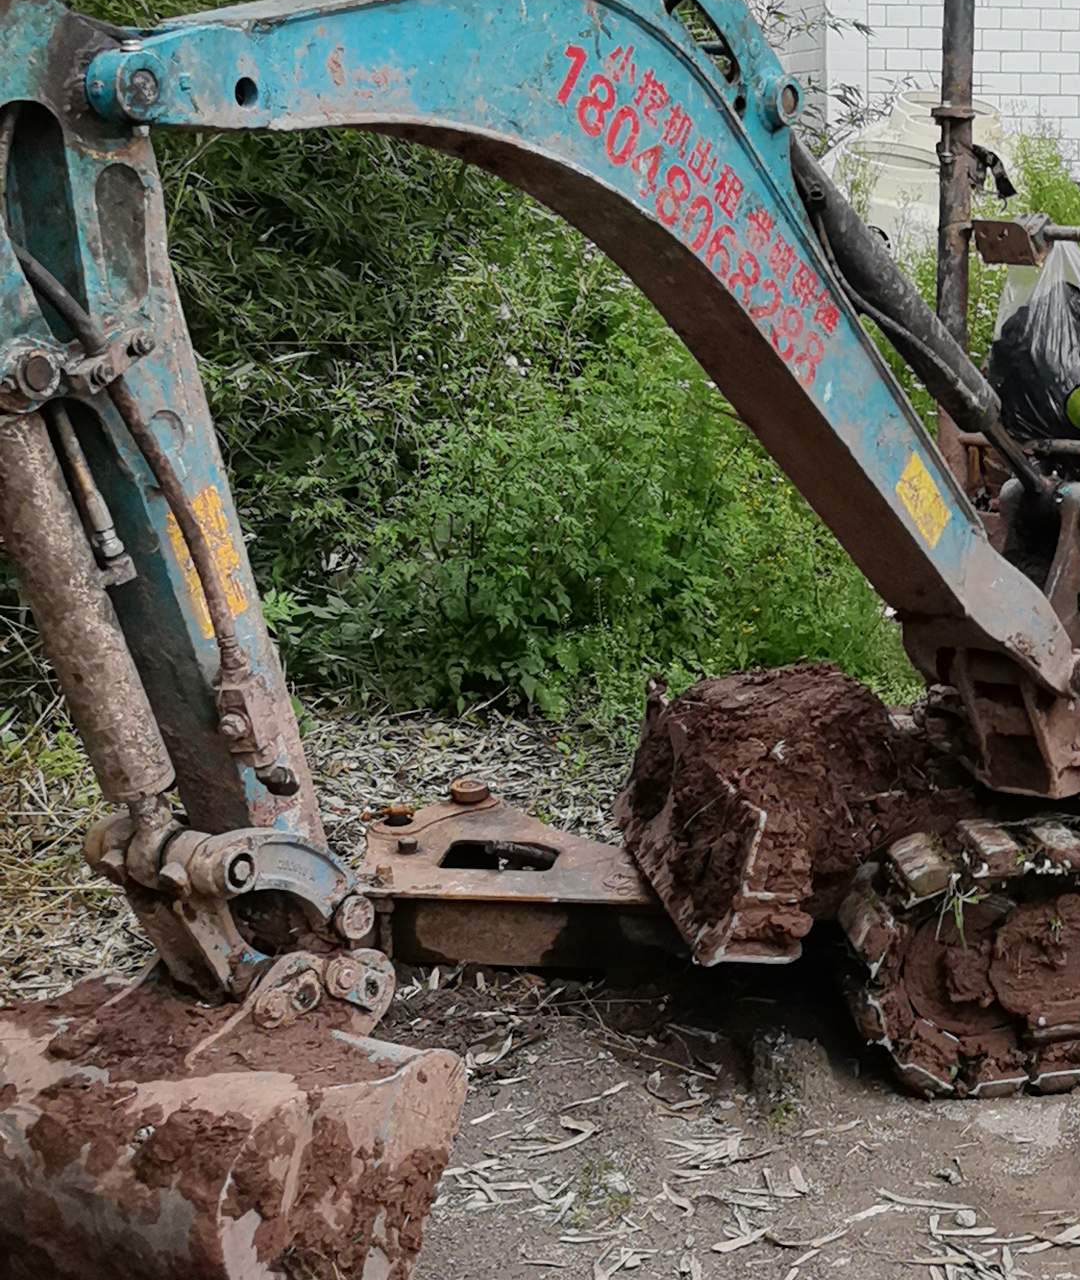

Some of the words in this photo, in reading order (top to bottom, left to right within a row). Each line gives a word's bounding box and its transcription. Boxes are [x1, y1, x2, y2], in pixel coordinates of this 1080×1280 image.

[556, 44, 826, 388] 18048068288
[604, 45, 746, 219] 小挖机出租
